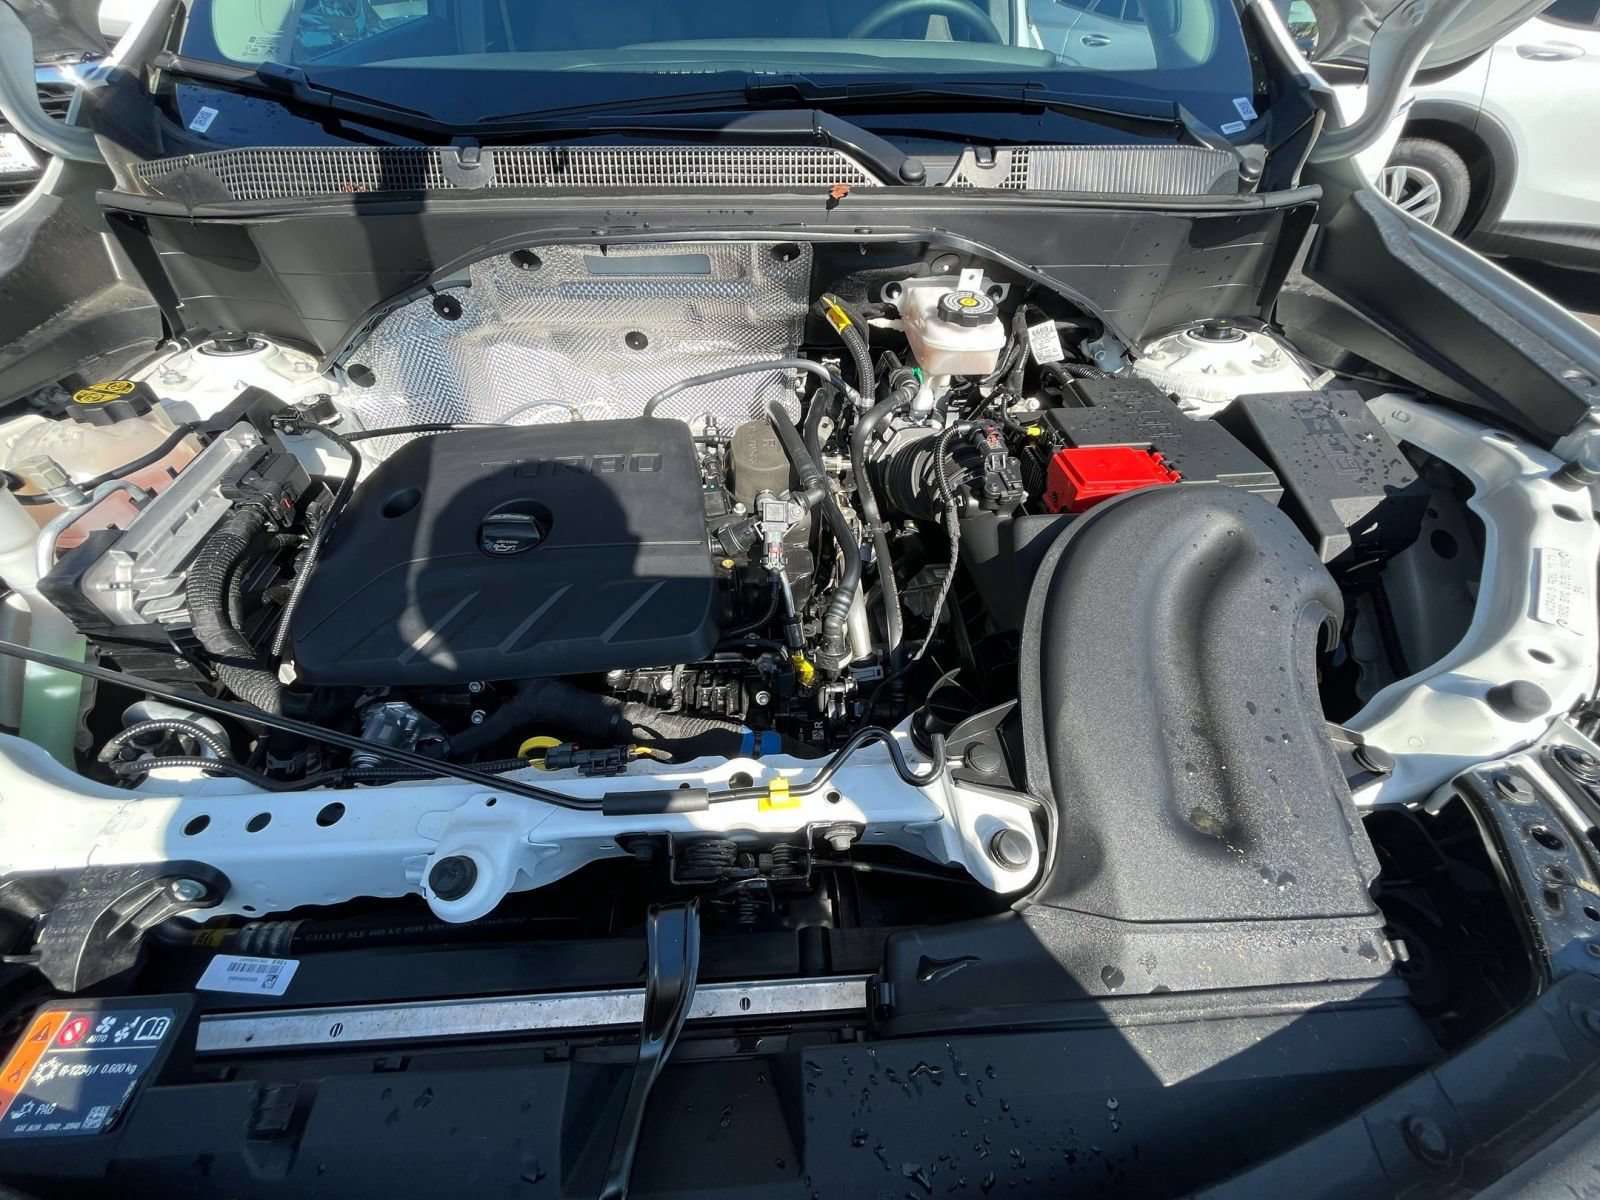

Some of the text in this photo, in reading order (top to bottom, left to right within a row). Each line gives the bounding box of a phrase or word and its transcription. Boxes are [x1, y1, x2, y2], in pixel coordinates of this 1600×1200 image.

[481, 453, 662, 480] TURBO
[86, 1034, 108, 1043] AUTO
[59, 1063, 137, 1076] R-1234yf 0.600 kg
[35, 1102, 57, 1115] PAG
